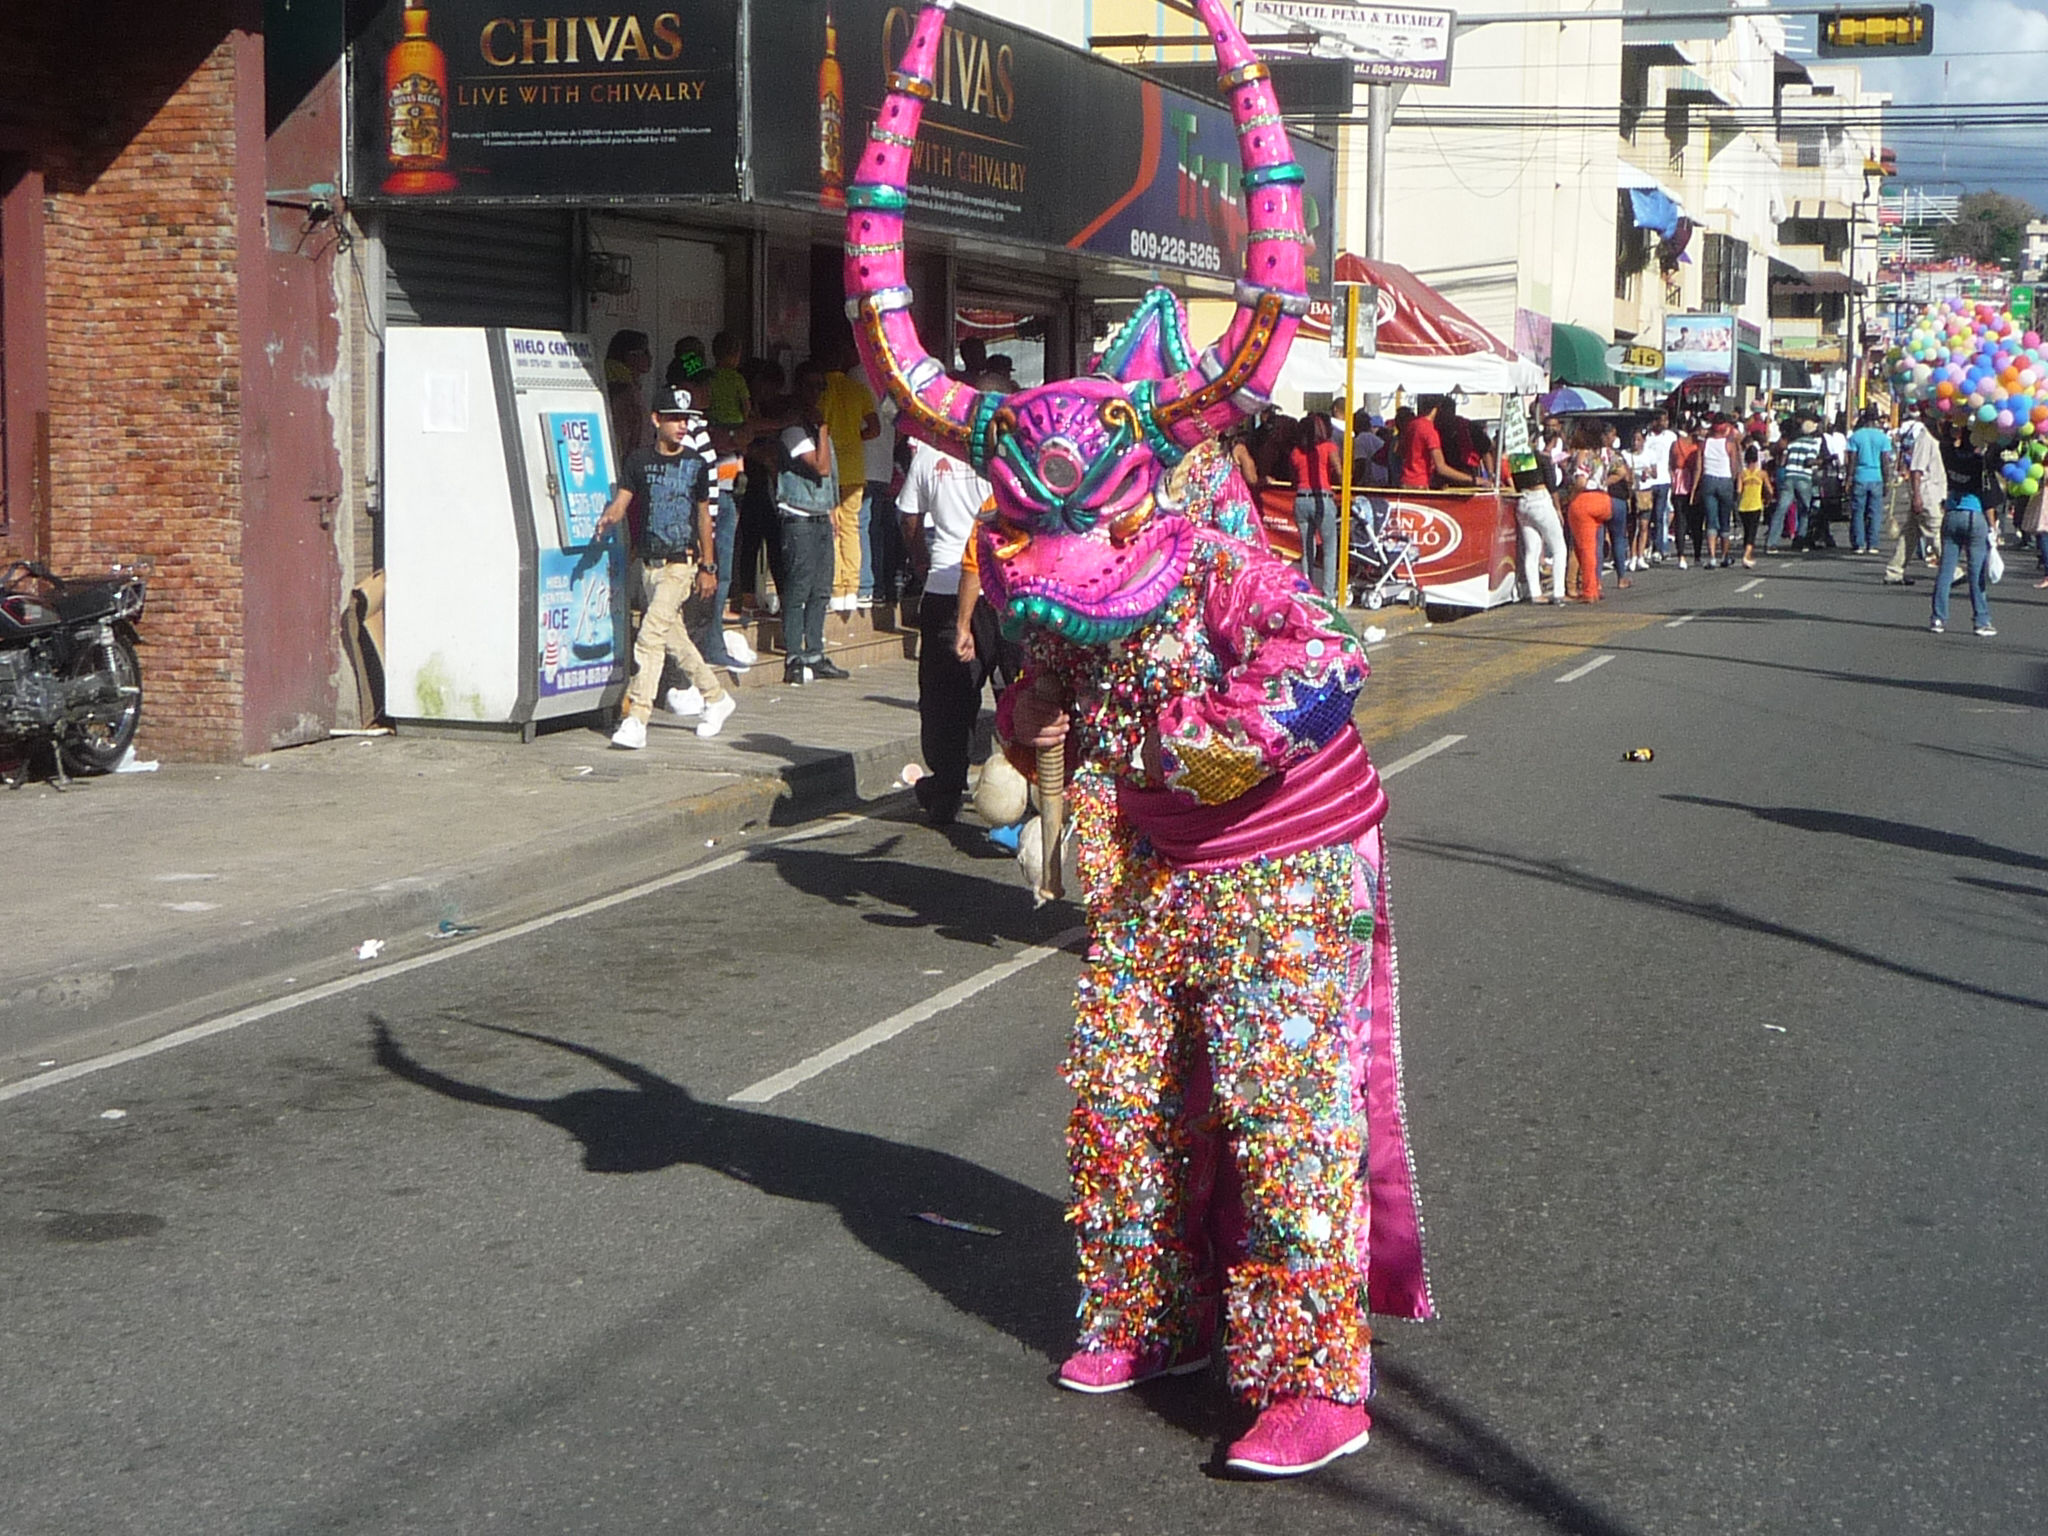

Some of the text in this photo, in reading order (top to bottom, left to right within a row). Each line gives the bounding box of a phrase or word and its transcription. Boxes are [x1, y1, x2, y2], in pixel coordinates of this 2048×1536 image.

[480, 12, 683, 67] CHIVAS
[882, 6, 1015, 123] CIVAS
[458, 81, 706, 106] LIVE WITH CHIVALRY
[958, 150, 1027, 193] CHIVALRY
[1130, 228, 1220, 272] 809-226-5265
[513, 338, 592, 359] HIELO CENTRAL
[1619, 348, 1656, 367] Lis
